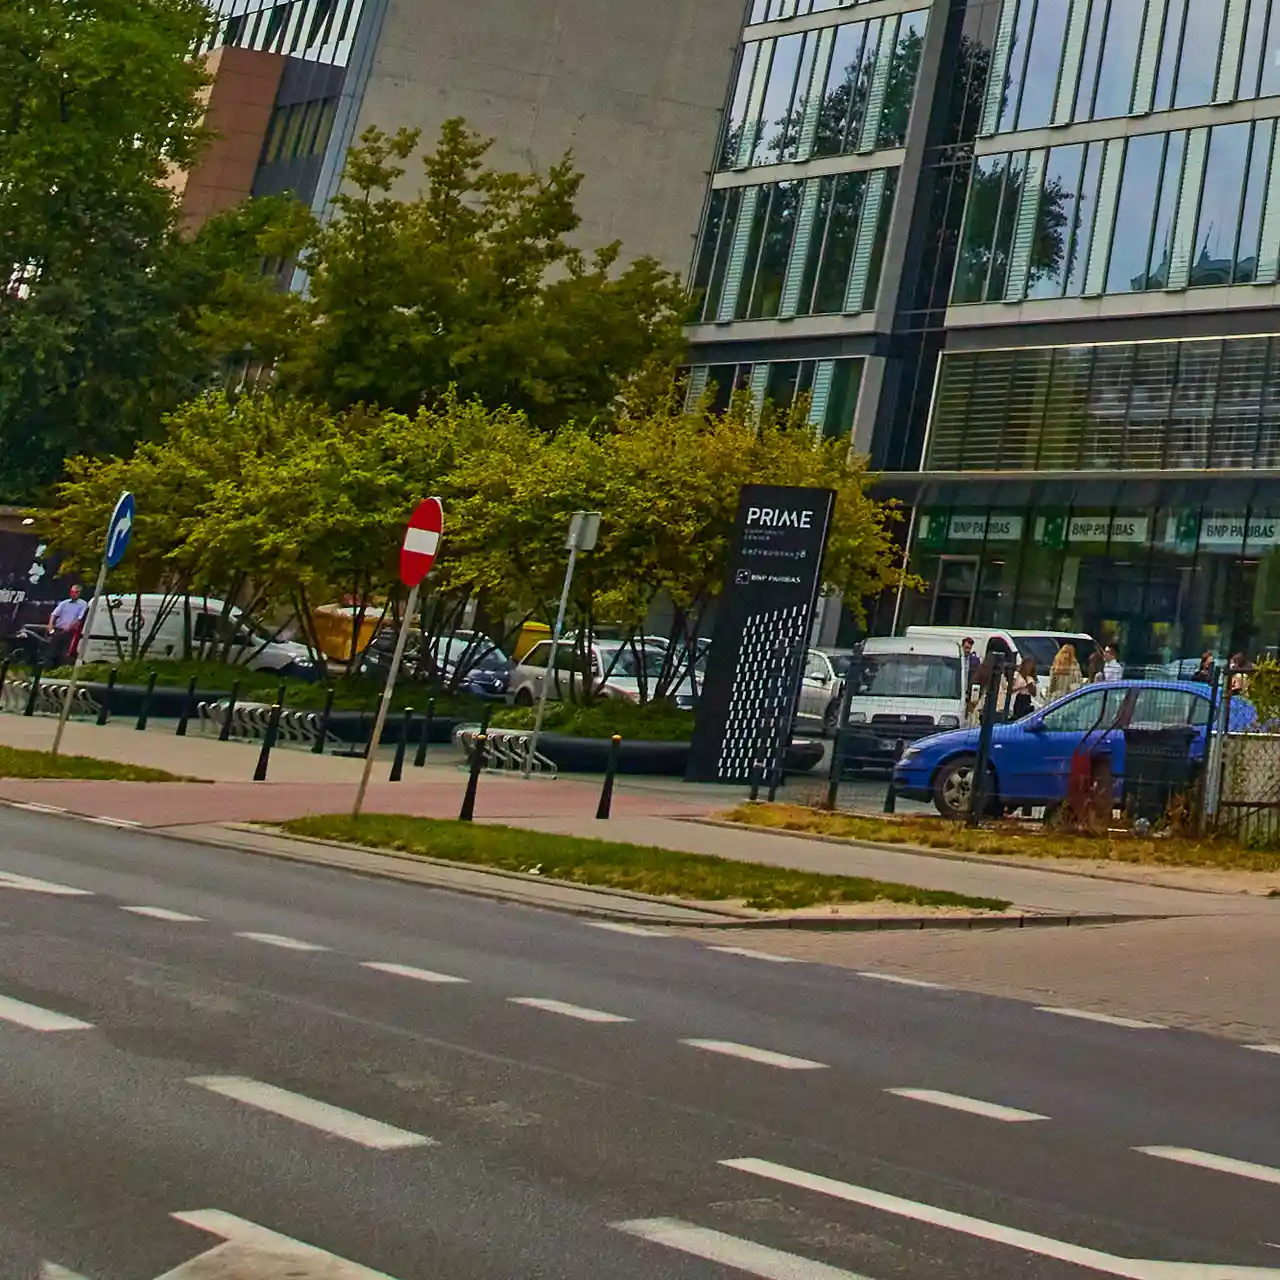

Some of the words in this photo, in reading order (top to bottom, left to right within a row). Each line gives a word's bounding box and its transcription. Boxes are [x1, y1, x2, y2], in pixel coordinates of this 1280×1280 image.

[746, 507, 813, 528] PRIME
[953, 522, 972, 533] BNP
[972, 521, 1011, 534] PAIBAS
[1071, 522, 1093, 536] BNP
[1206, 524, 1229, 537] BNP
